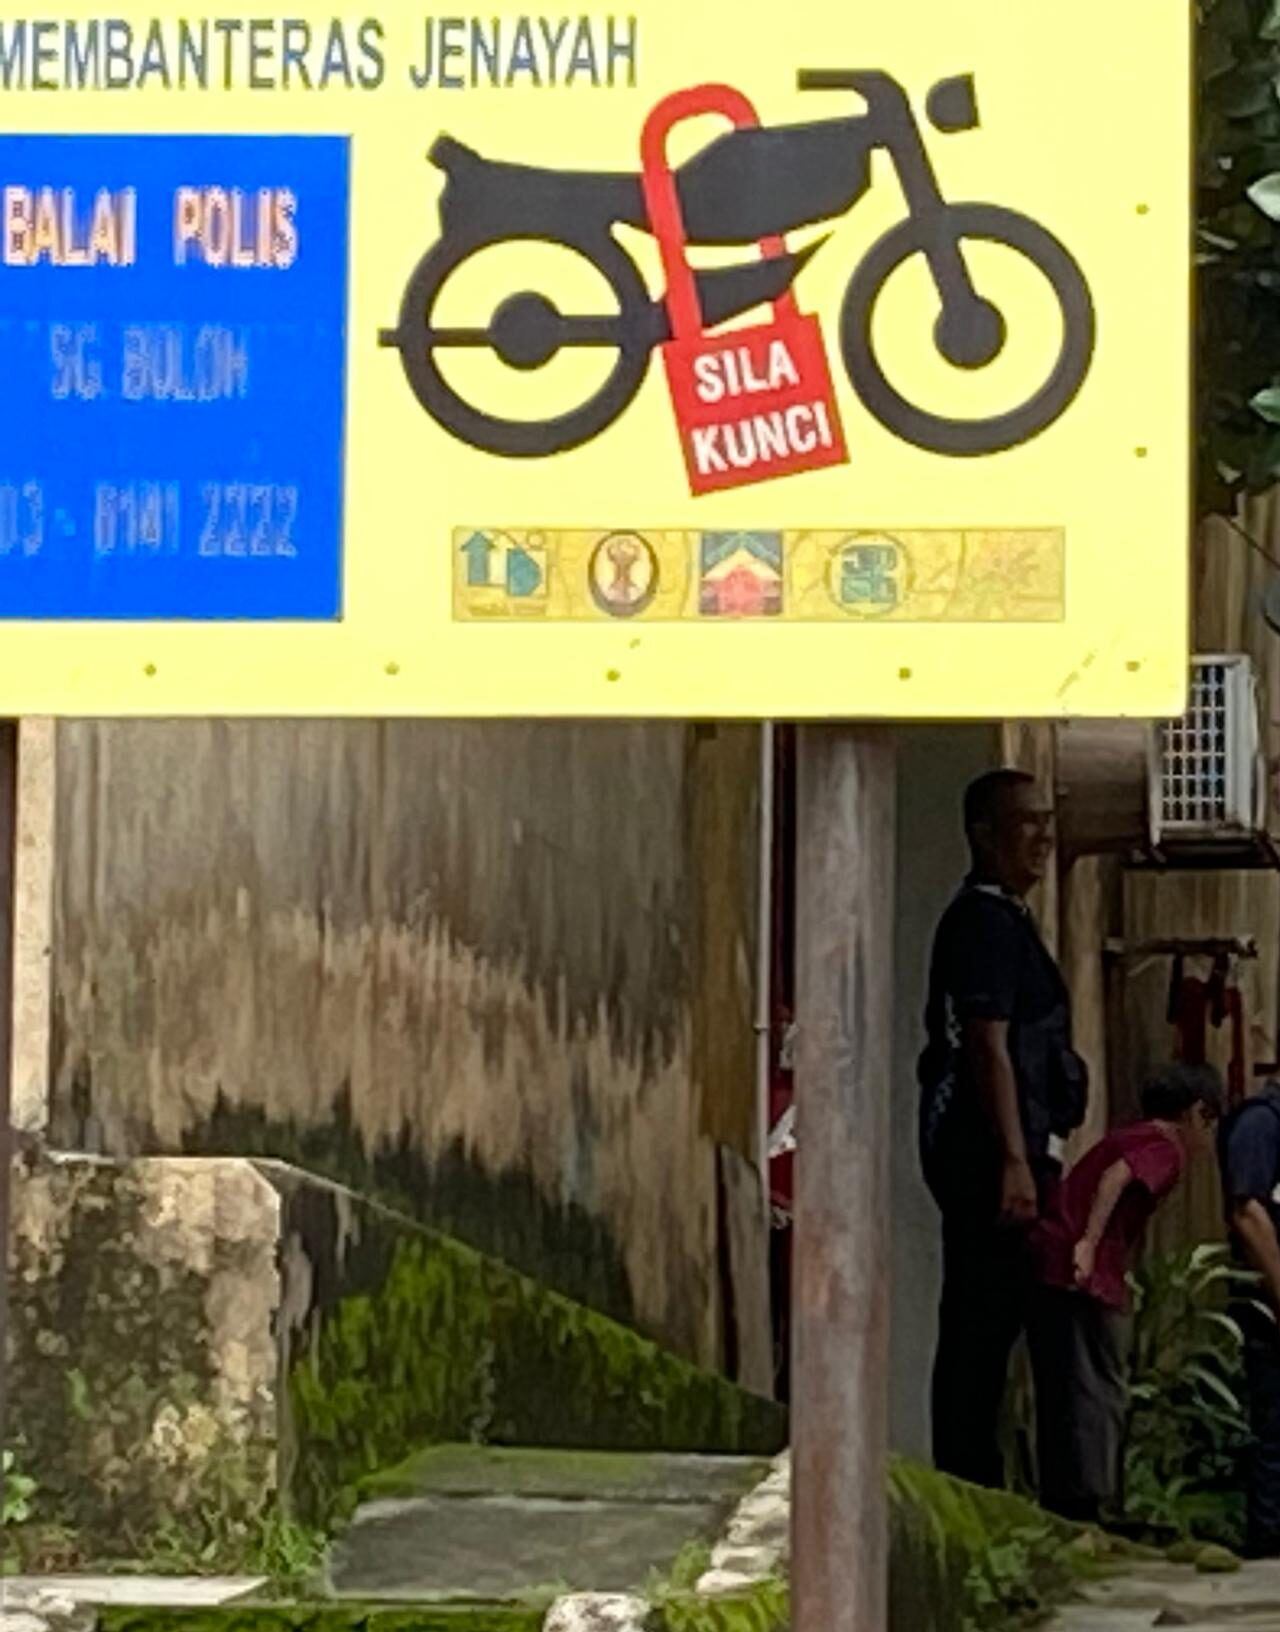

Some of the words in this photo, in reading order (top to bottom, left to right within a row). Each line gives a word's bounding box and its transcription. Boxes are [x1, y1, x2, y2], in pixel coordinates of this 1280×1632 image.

[0, 18, 385, 91] MEMBANTERAS
[409, 15, 637, 89] JENAYAH
[2, 184, 137, 267] BALAI
[173, 184, 298, 269] POLIS
[694, 340, 800, 403] SILA
[691, 401, 833, 475] KUNCI
